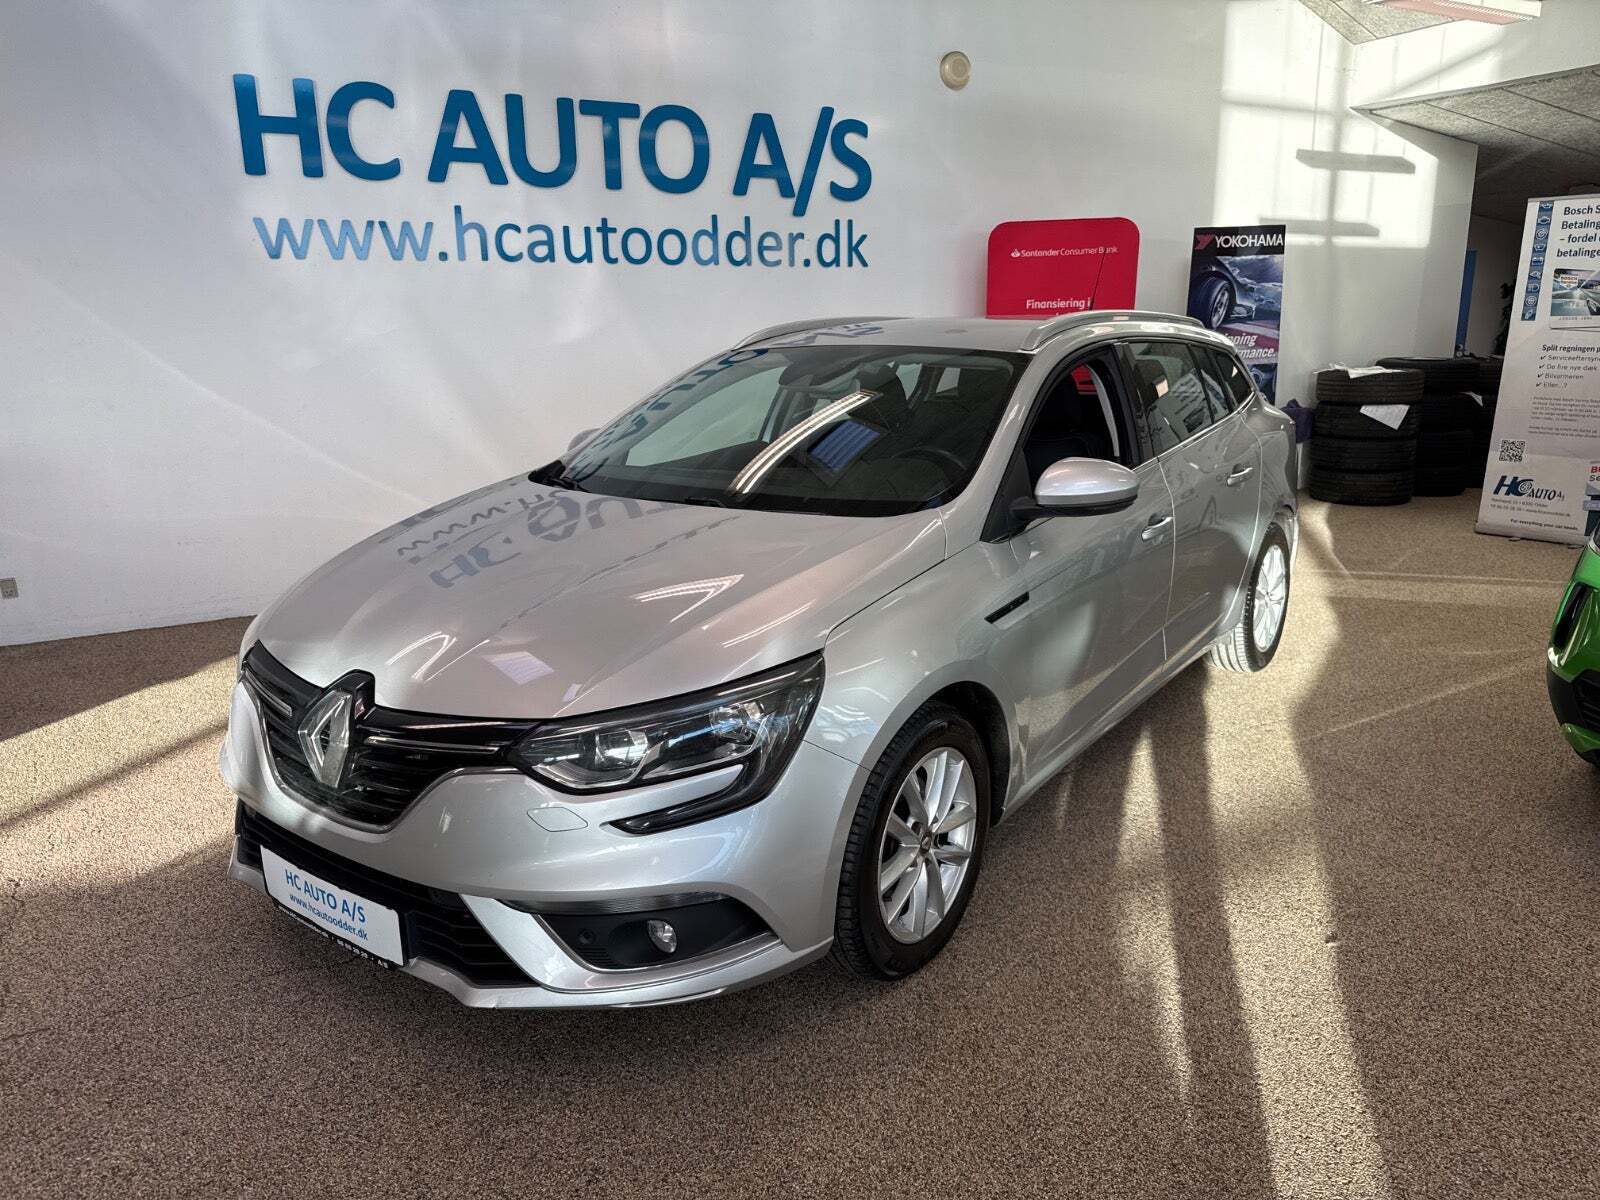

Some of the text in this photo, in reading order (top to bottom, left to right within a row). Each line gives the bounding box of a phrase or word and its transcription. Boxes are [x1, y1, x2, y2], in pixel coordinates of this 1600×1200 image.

[233, 73, 872, 217] HC AUTO A/S
[1564, 205, 1593, 215] Bosch
[252, 205, 869, 268] www.hcautoodder.dk
[1215, 234, 1284, 248] YOKOHAMA
[1567, 233, 1597, 243] fordel
[1026, 298, 1084, 310] Finansiering
[1542, 344, 1558, 352] Split
[1560, 345, 1595, 353] regningen
[1527, 487, 1557, 501] AUTO
[285, 869, 301, 890] HC
[304, 881, 337, 910] AUTO
[341, 899, 366, 923] A/S
[289, 894, 368, 940] www.hcautoodder.dk
